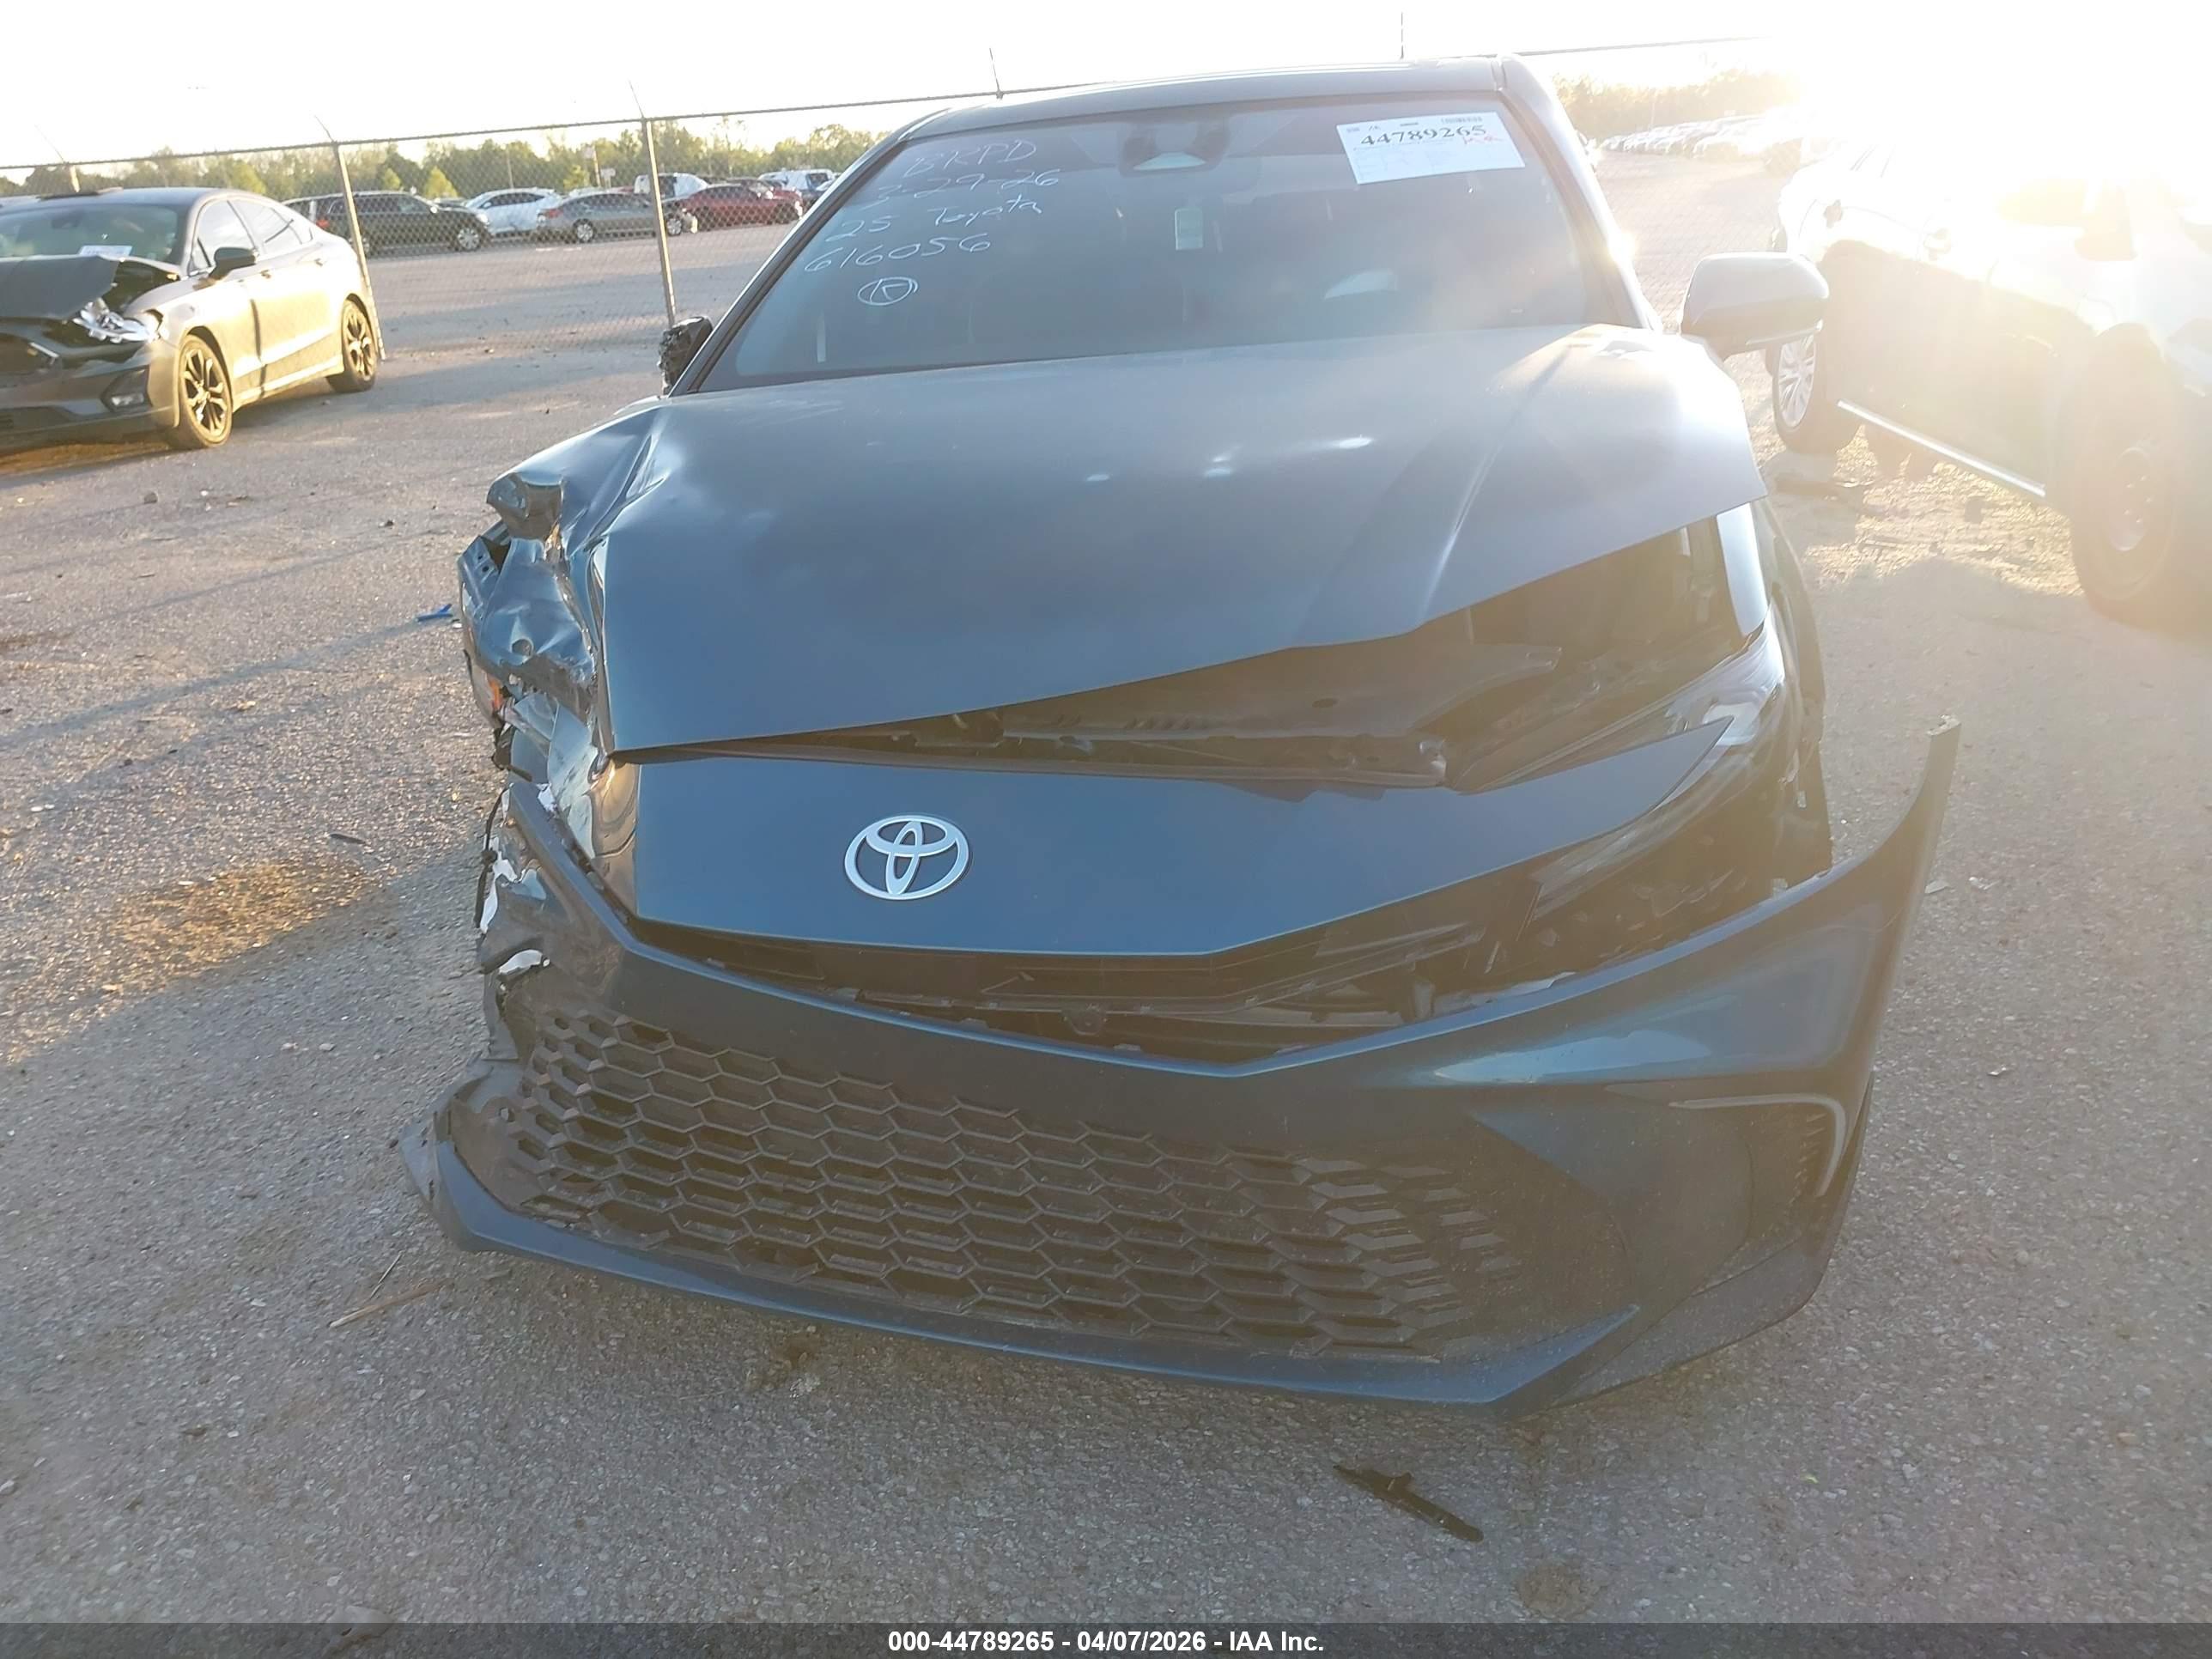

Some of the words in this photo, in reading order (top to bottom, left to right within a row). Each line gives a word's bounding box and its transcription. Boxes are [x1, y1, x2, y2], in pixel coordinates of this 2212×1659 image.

[1360, 125, 1486, 145] 44789265
[927, 194, 1042, 227] Toyota
[805, 233, 991, 271] 616056
